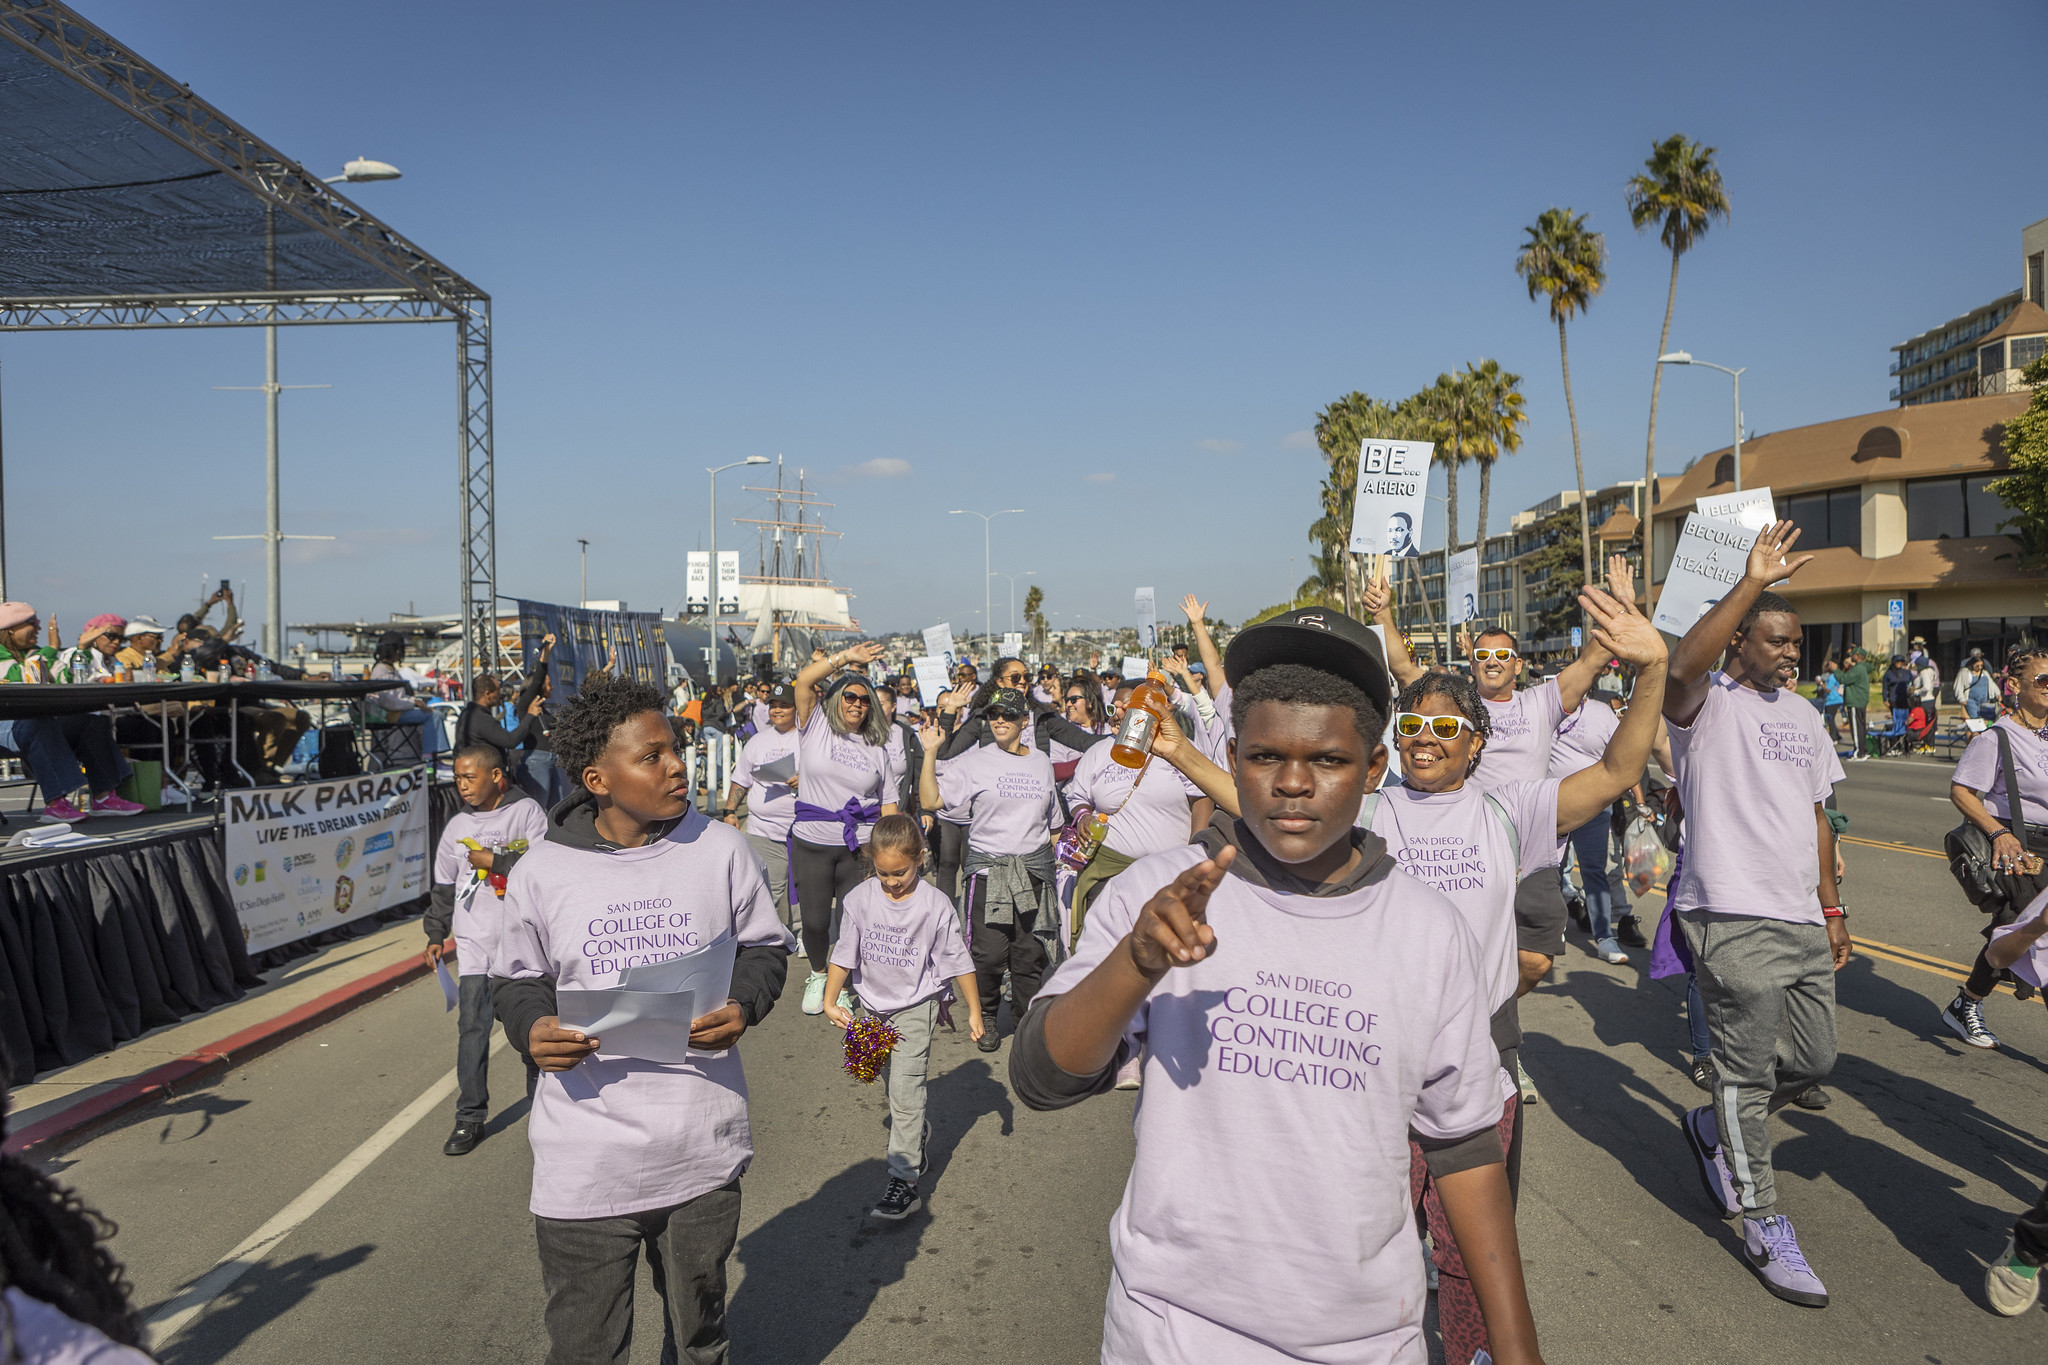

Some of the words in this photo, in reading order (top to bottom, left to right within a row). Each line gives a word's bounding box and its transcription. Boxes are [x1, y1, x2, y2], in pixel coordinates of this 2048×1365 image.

[1363, 443, 1421, 477] BE...
[1363, 479, 1375, 494] A
[1376, 479, 1418, 496] HERO
[1706, 547, 1720, 562] A
[721, 560, 736, 568] VISIT
[1776, 722, 1798, 730] DIEGO
[1758, 735, 1815, 757] CONUING
[1798, 733, 1809, 744] OF
[996, 783, 1046, 793] CONTINUING
[998, 776, 1030, 785] COLLEGE
[230, 788, 306, 824] MLK
[315, 767, 425, 812] PARADE
[999, 790, 1043, 800] EDUCATION
[256, 826, 289, 845] LIVE
[292, 822, 317, 839] THE
[318, 815, 358, 834] DREAM
[358, 809, 381, 826] SAN
[1409, 836, 1429, 846] SAN
[1430, 836, 1464, 846] DIEGO
[1397, 847, 1459, 862] COLLEGE
[1461, 844, 1480, 859] OF
[1395, 860, 1486, 877] ONTINUING
[1424, 876, 1484, 892] ATION
[607, 902, 631, 915] SAN
[633, 897, 672, 911] DIEGO
[587, 914, 666, 937] COLLEGE
[668, 912, 692, 928] OF
[873, 922, 886, 930] SAN
[885, 925, 908, 934] DIEGO
[582, 931, 698, 958] CONTINUING
[864, 928, 902, 944] COLLEGE
[590, 951, 685, 976] EDUCATIO
[861, 949, 915, 968] EDUCATION
[1255, 970, 1291, 989] SAN
[1295, 976, 1352, 999] DIEGO
[1223, 986, 1340, 1028] COLLEGE
[1345, 1009, 1378, 1034] OF
[1211, 1016, 1382, 1066] CONTINUING
[1217, 1046, 1367, 1092] EDUCATION
